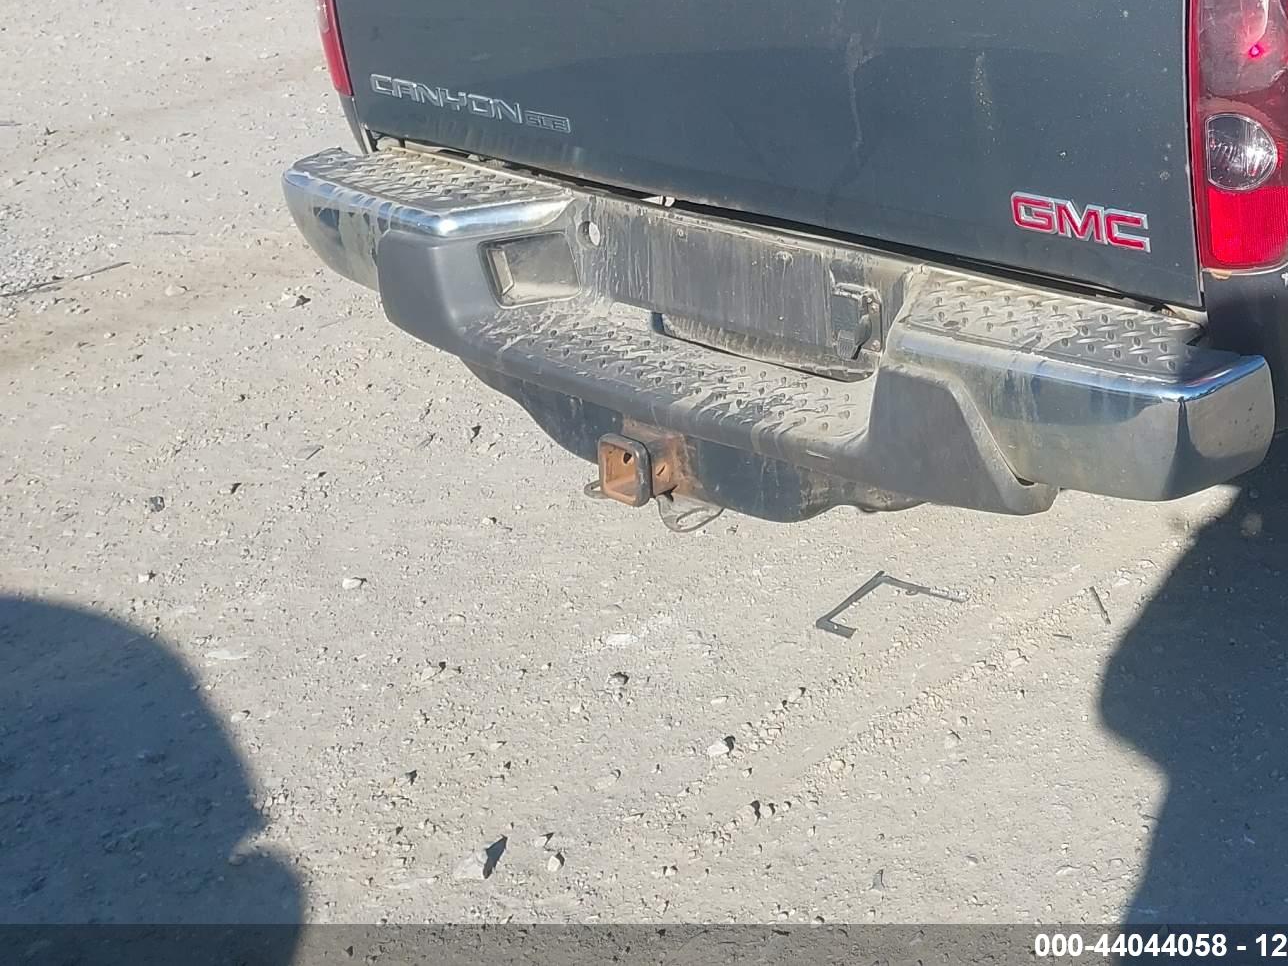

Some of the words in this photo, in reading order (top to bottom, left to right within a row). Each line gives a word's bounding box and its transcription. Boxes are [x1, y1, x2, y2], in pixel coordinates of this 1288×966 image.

[370, 73, 523, 124] CANYON
[525, 111, 570, 133] SLE
[1010, 191, 1151, 253] GMC
